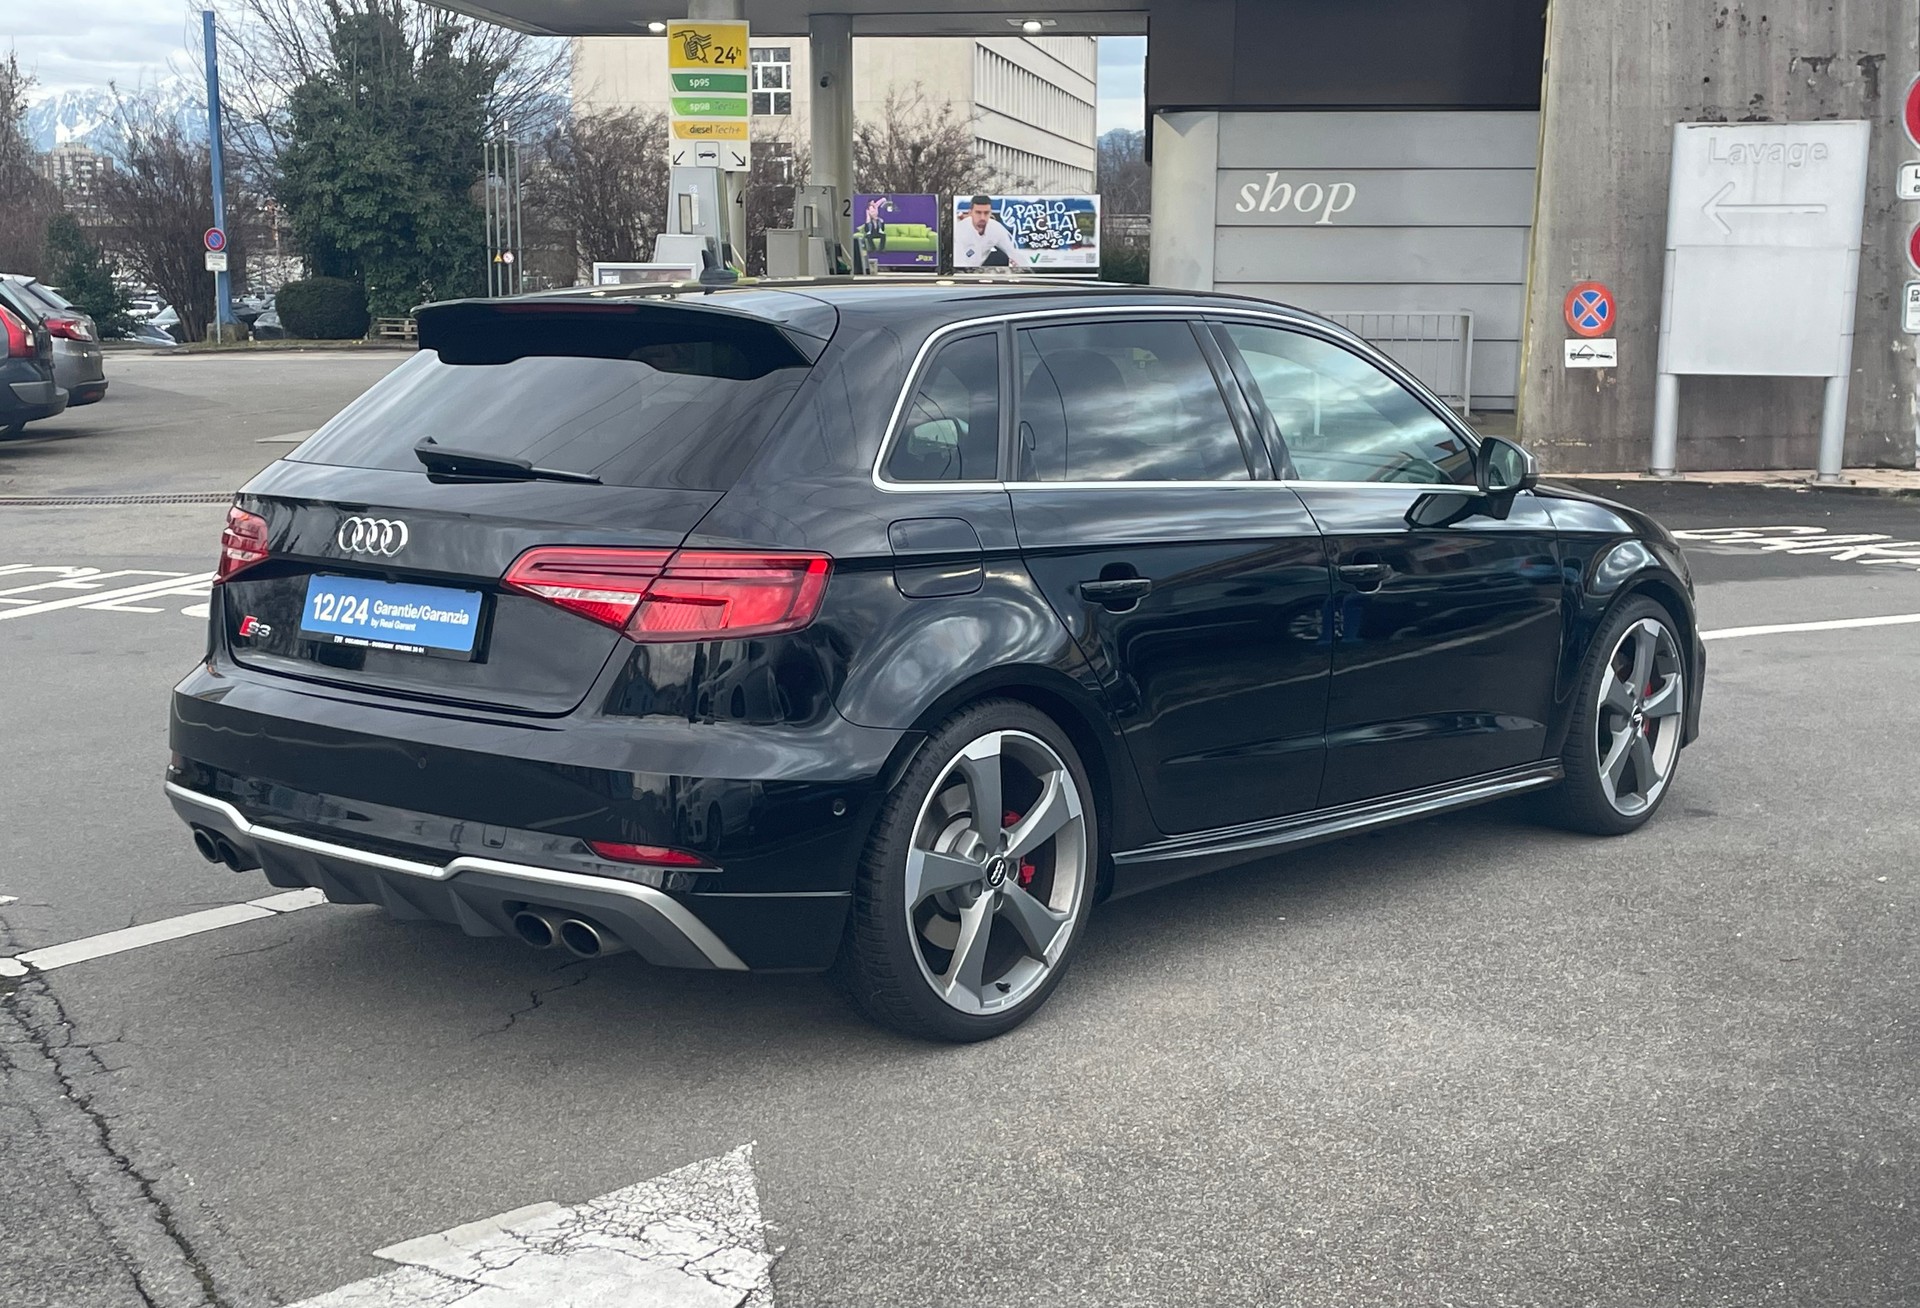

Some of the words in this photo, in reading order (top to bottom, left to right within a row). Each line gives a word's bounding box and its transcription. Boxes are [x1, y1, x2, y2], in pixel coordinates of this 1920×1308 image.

[689, 78, 710, 89] sp95
[689, 102, 710, 112] sp98
[689, 125, 712, 134] diesel
[714, 125, 741, 134] Tech+
[1708, 137, 1829, 168] Lavage
[736, 190, 744, 208] 4
[1235, 171, 1356, 225] shop
[843, 199, 851, 217] 2
[1013, 201, 1066, 219] PABLO
[1016, 210, 1081, 235] LACHAT
[1028, 240, 1050, 248] POUR
[1049, 229, 1083, 248] 2026
[1029, 229, 1062, 241] ROUTE
[313, 593, 370, 626] 12/24
[373, 600, 469, 625] Garantie/Garanzia
[246, 621, 271, 637] S3
[370, 618, 379, 629] by
[379, 619, 394, 629] Real
[394, 620, 417, 632] Garant
